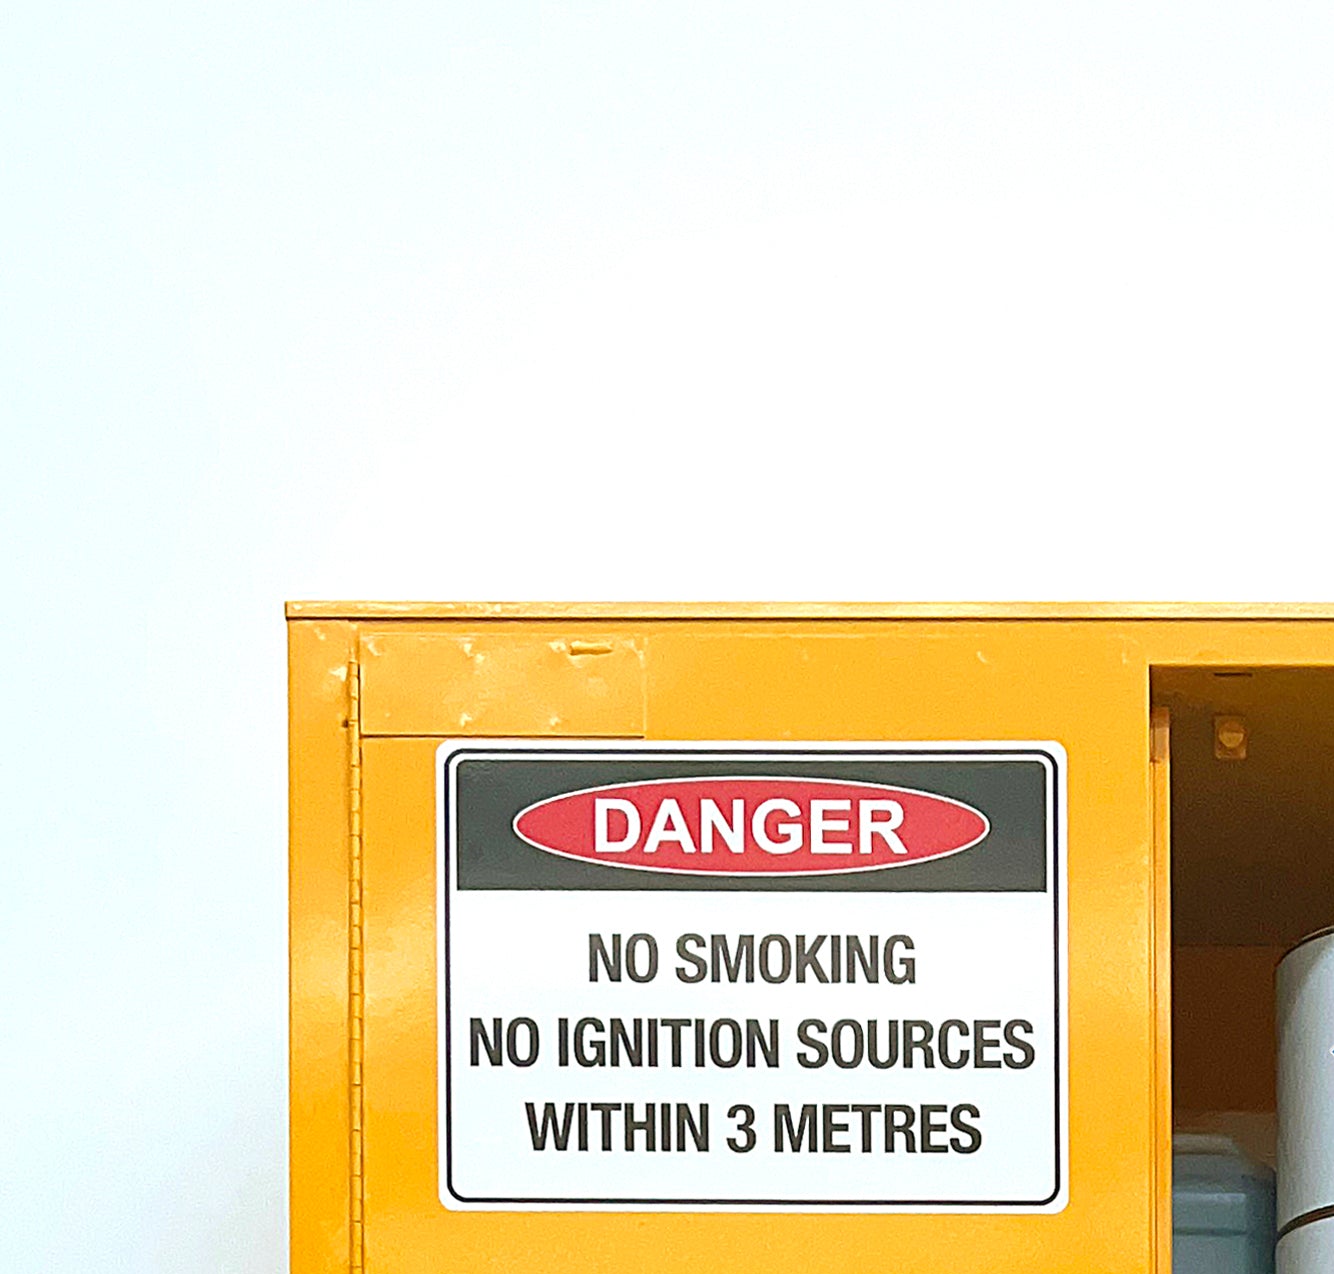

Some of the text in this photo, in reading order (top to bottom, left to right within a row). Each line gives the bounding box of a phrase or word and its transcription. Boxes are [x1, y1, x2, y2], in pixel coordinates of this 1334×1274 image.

[593, 797, 909, 856] DANGER
[587, 933, 917, 985] NO SMOKING
[469, 1016, 1036, 1070] NO IGNITION SOURCES
[524, 1101, 982, 1154] WITHIN 3 METRES
